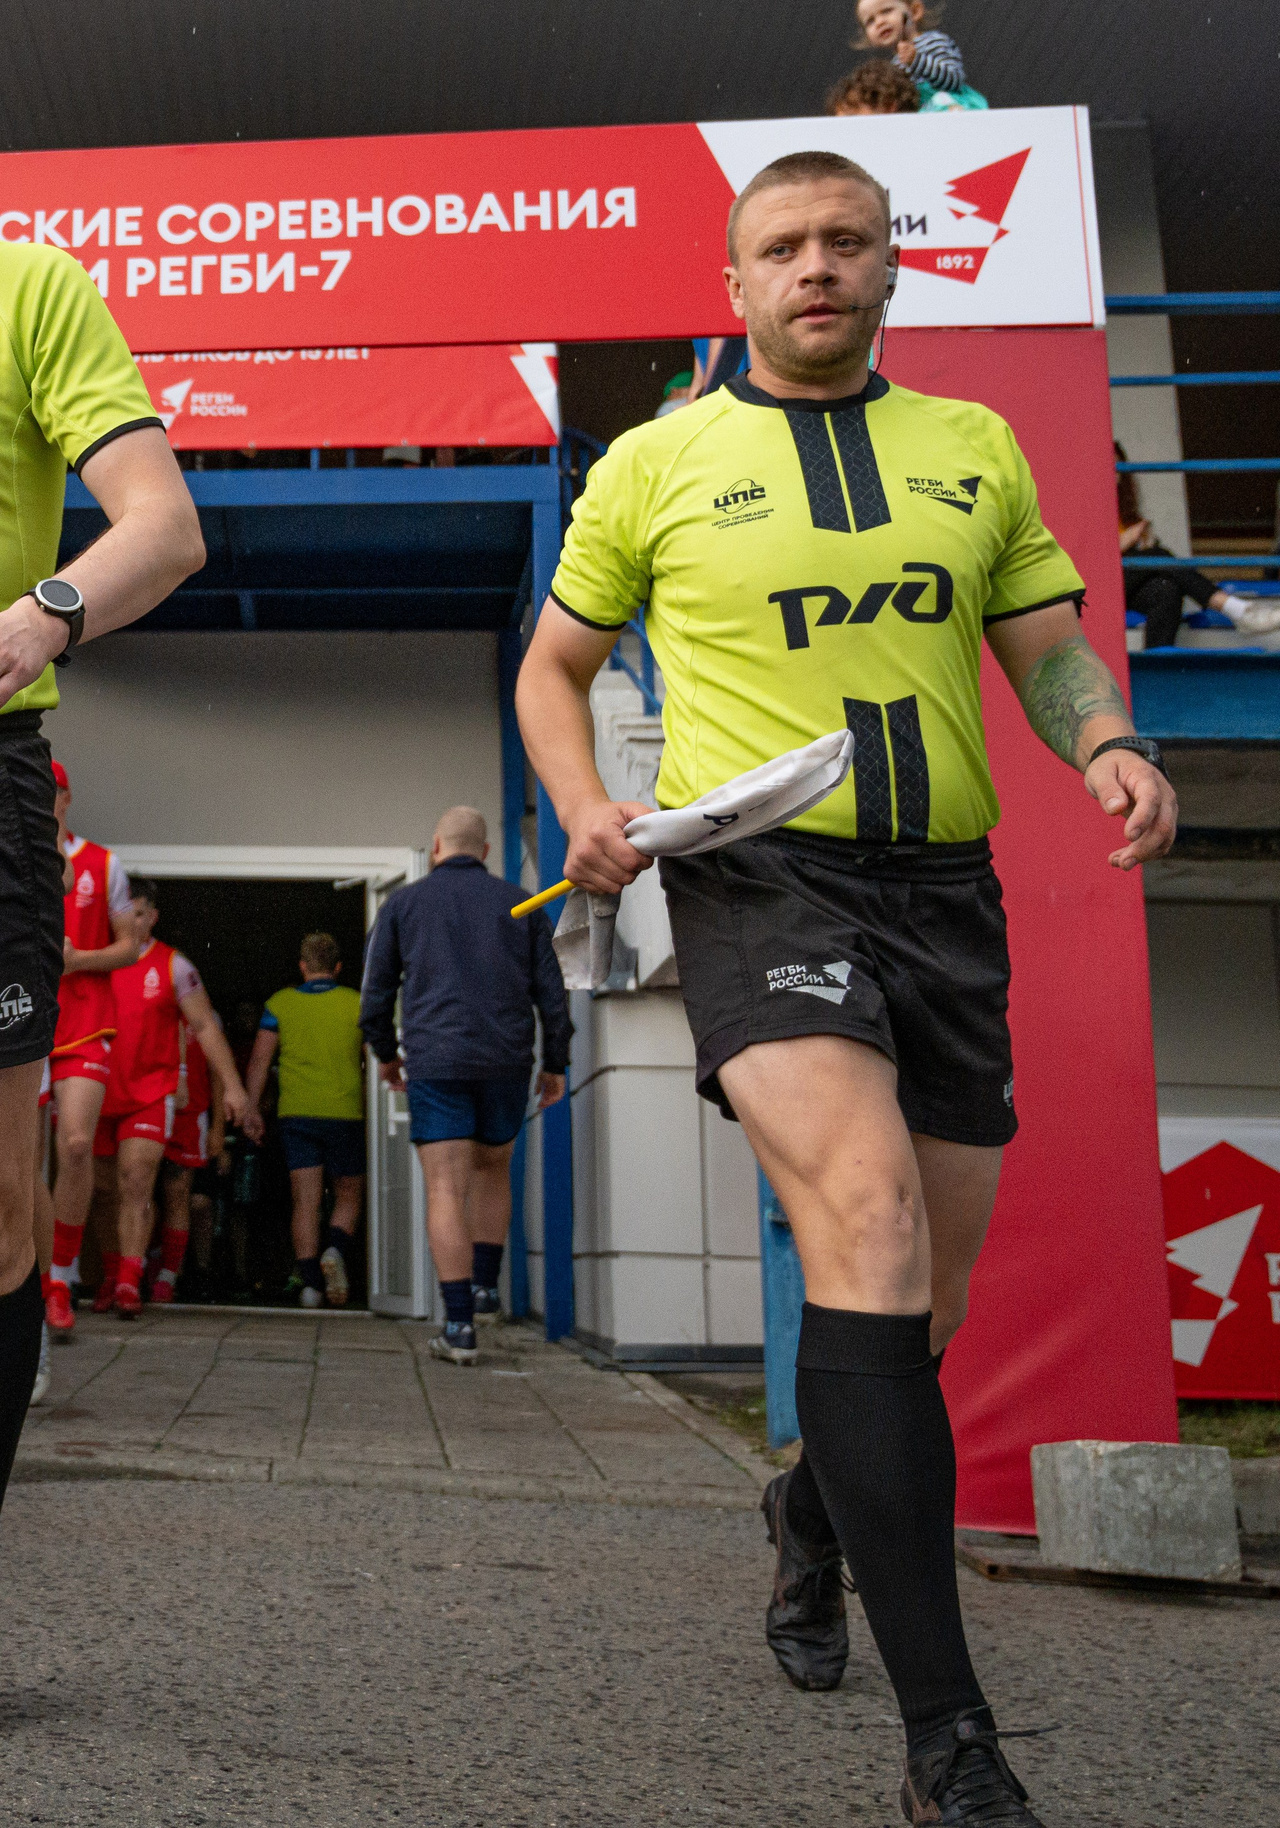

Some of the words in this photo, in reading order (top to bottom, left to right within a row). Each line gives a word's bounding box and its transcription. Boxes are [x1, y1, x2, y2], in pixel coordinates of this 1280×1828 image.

[157, 186, 637, 245] СОРЕВНОВАНИЯ
[936, 254, 975, 270] 1892
[126, 250, 352, 298] РЕГБИ-7
[190, 404, 248, 417] РОССИИ
[906, 477, 944, 488] РЕГБИ
[908, 486, 957, 498] РОССИИ
[766, 965, 807, 980] РЕГБИ
[769, 973, 824, 991] РОССИИ
